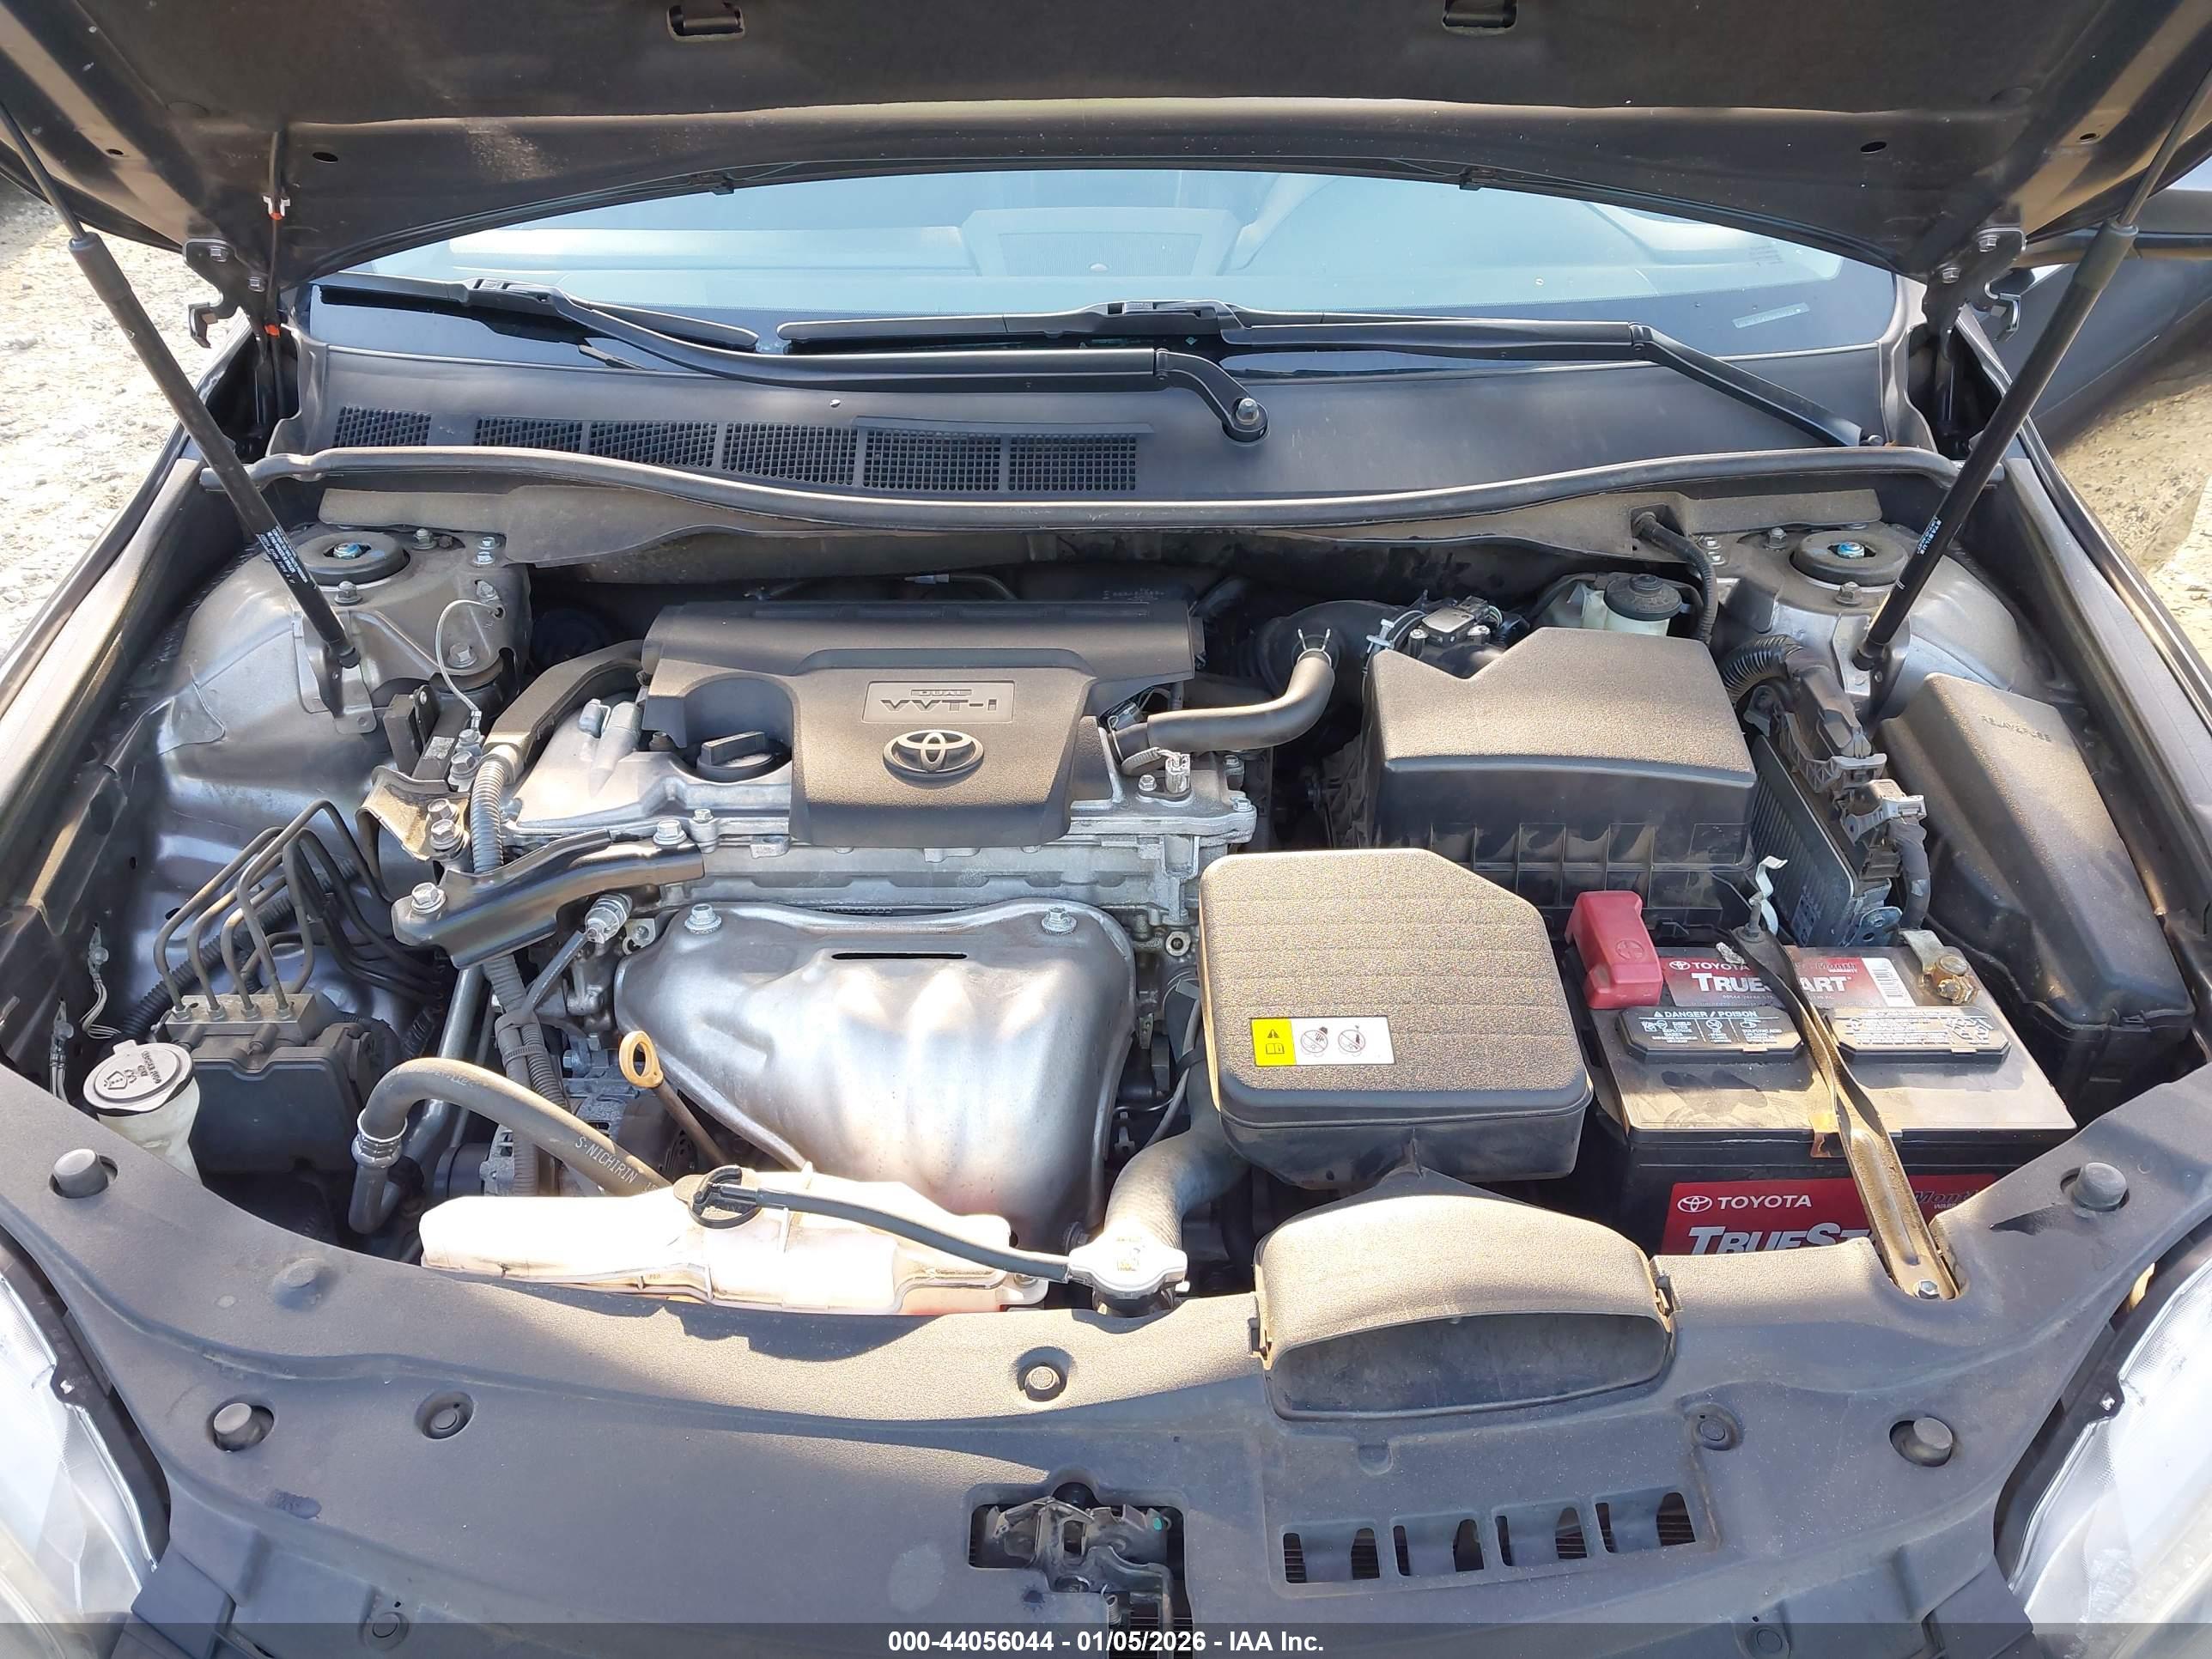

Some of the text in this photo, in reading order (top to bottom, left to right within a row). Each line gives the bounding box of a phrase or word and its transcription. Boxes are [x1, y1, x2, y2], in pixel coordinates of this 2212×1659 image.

[1920, 520, 1942, 555] STABILUS
[1691, 962, 1751, 971] TOYOTA
[1717, 1194, 1813, 1210] TOYOTA
